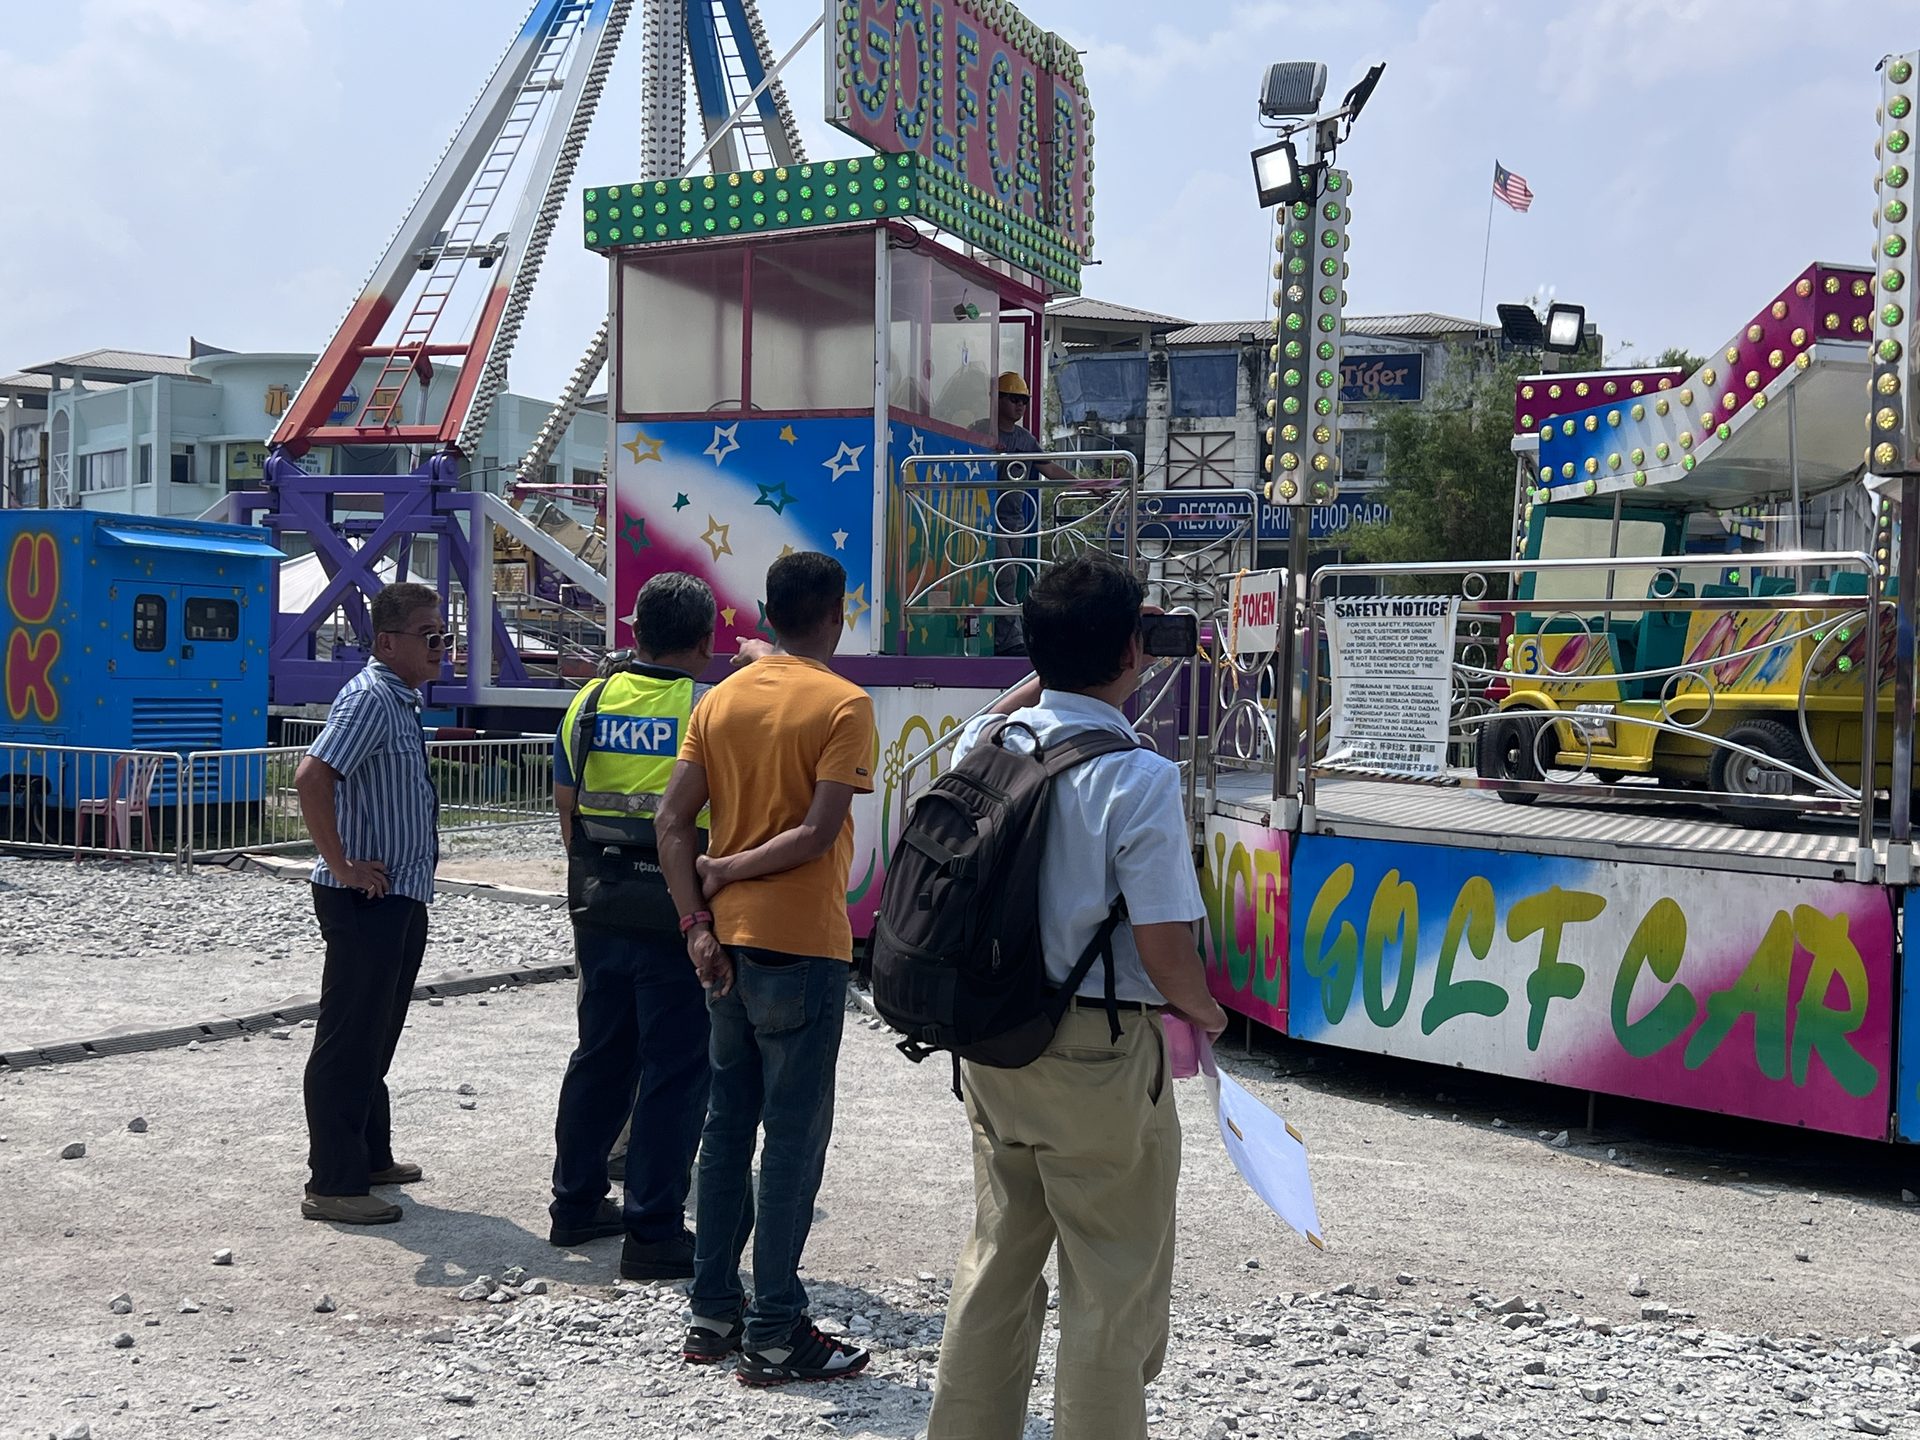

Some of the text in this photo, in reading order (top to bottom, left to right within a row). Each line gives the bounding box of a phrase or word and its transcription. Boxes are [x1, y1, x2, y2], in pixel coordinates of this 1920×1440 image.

[1340, 361, 1408, 397] Tiger
[1178, 502, 1252, 530] RESTORA
[1311, 503, 1349, 530] FOOD
[1335, 601, 1448, 617] SAFETY NOTICE
[1525, 646, 1538, 674] 3
[593, 720, 672, 750] JKKP
